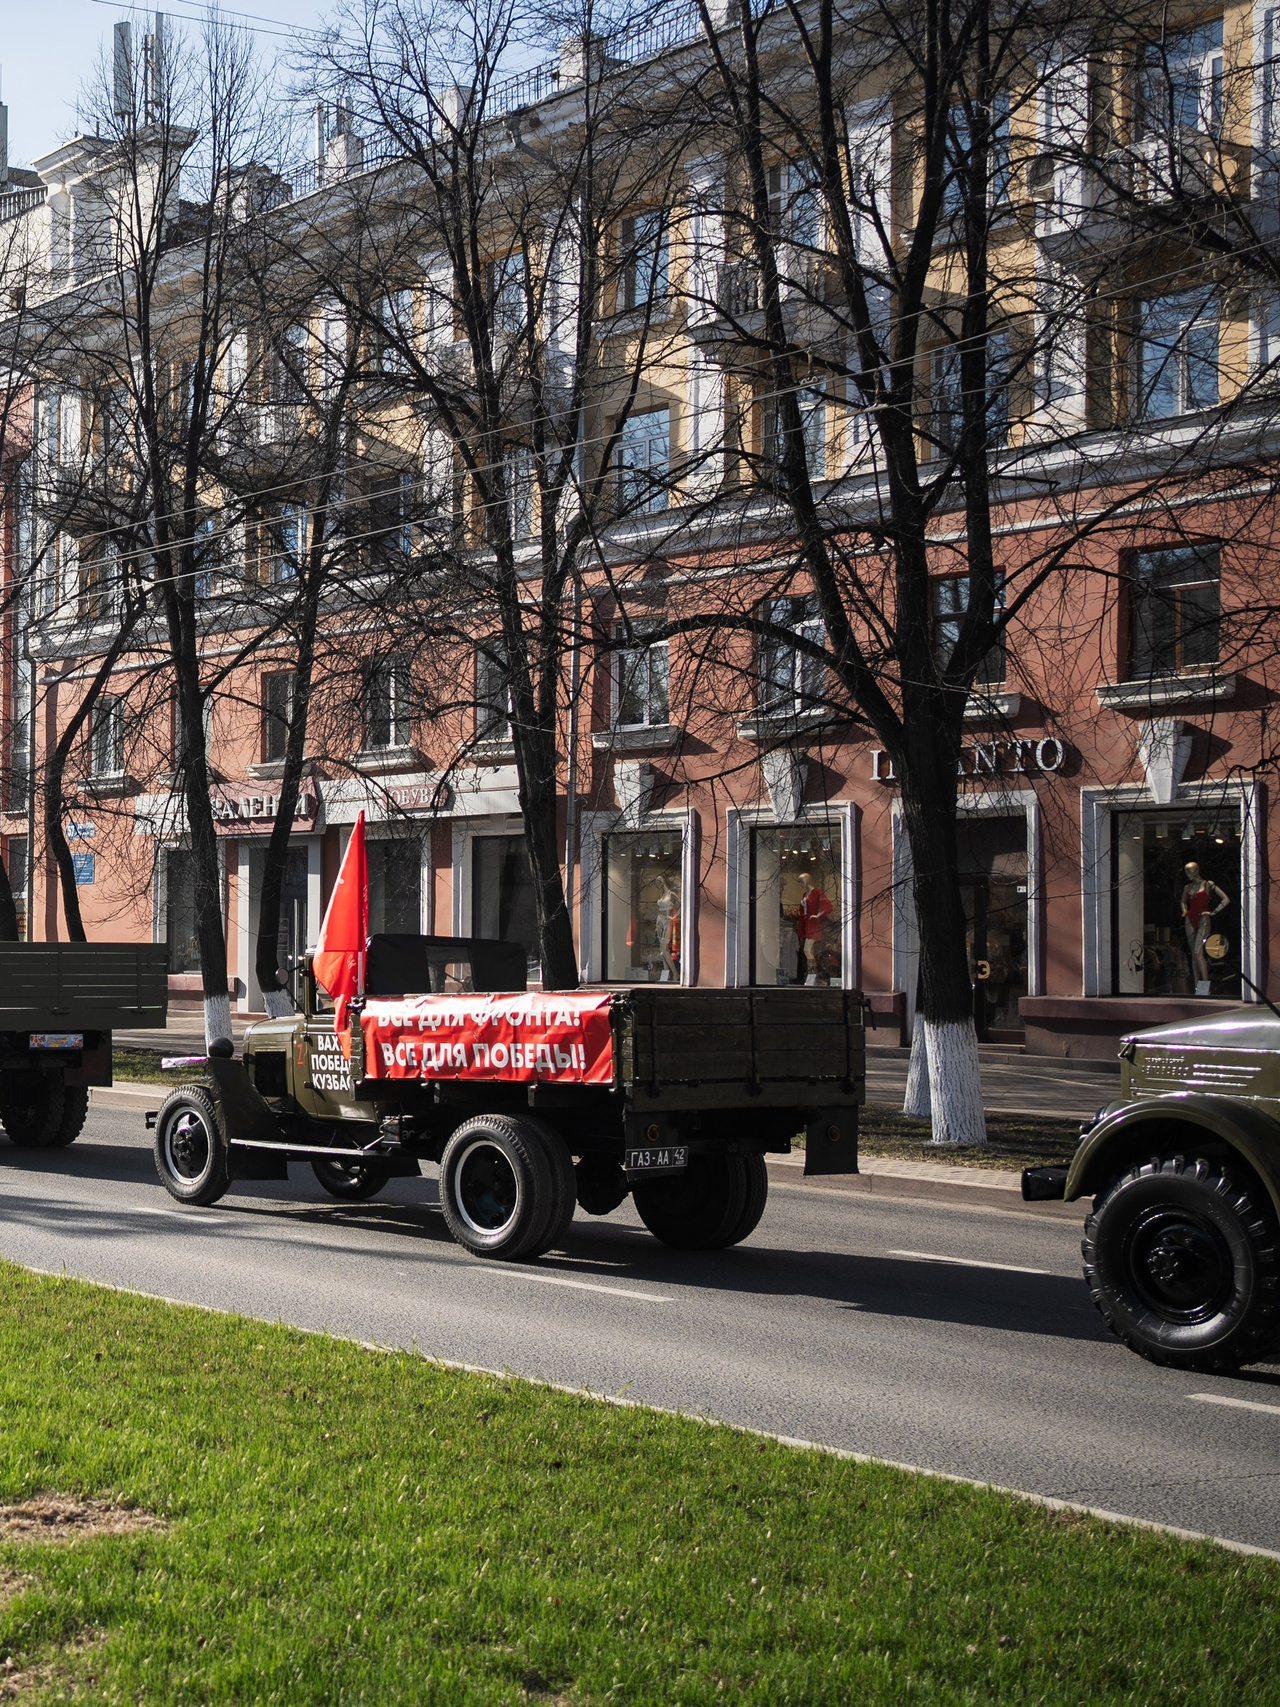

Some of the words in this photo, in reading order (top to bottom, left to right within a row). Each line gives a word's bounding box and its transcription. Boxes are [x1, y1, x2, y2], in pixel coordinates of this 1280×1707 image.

[870, 736, 1064, 781] INTO
[210, 792, 309, 820] ВАЛЕНИ
[418, 1009, 464, 1031] ДЛЯ
[471, 1008, 581, 1028] ФРОНТА!
[317, 1035, 343, 1051] ВАХ
[311, 1054, 351, 1074] ПОБЕД
[381, 1042, 417, 1068] ВСЕ
[421, 1042, 468, 1072] ДЛЯ
[472, 1042, 587, 1074] ПОБЕДЫ!
[630, 1150, 670, 1168] ГАЗ-АА
[674, 1148, 685, 1160] 42
